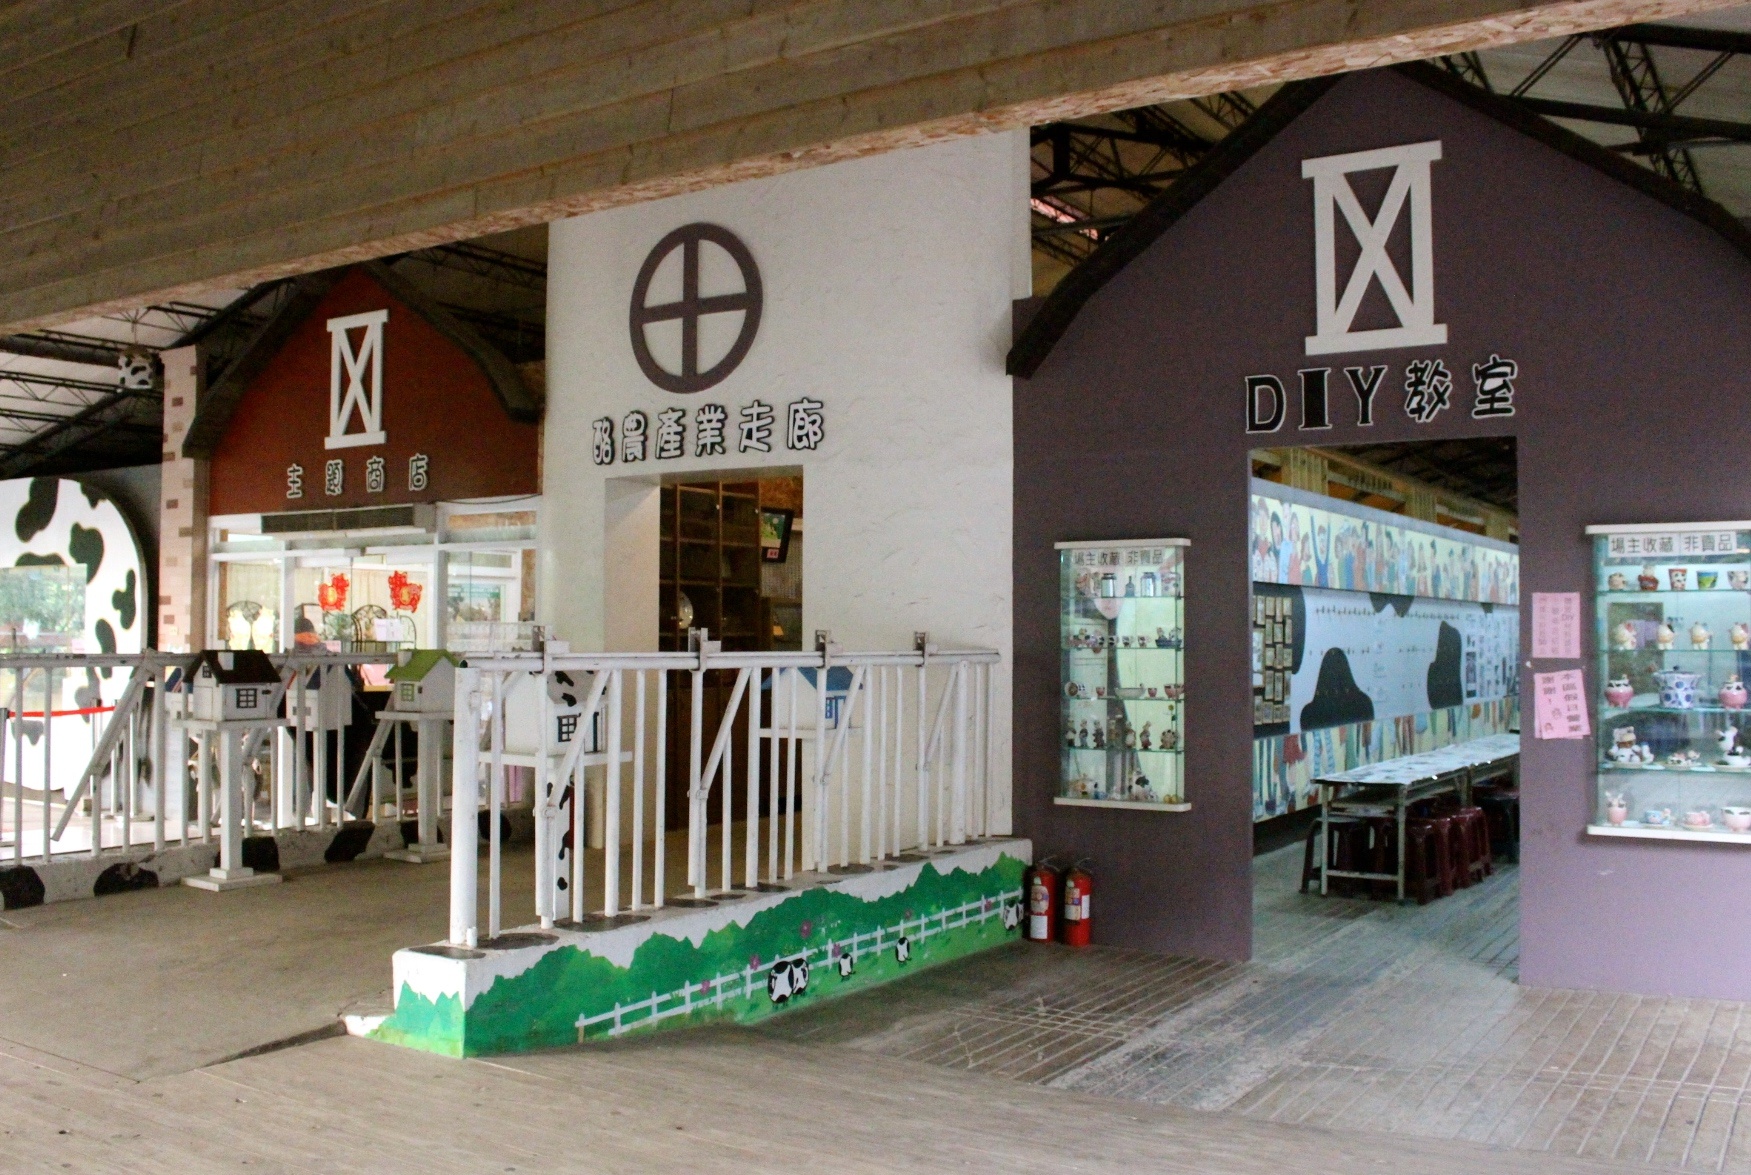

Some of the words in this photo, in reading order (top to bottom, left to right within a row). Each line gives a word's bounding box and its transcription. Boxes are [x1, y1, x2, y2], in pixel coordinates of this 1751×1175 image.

[592, 397, 824, 465] 酪農產業走廊
[286, 453, 428, 499] 主題商店
